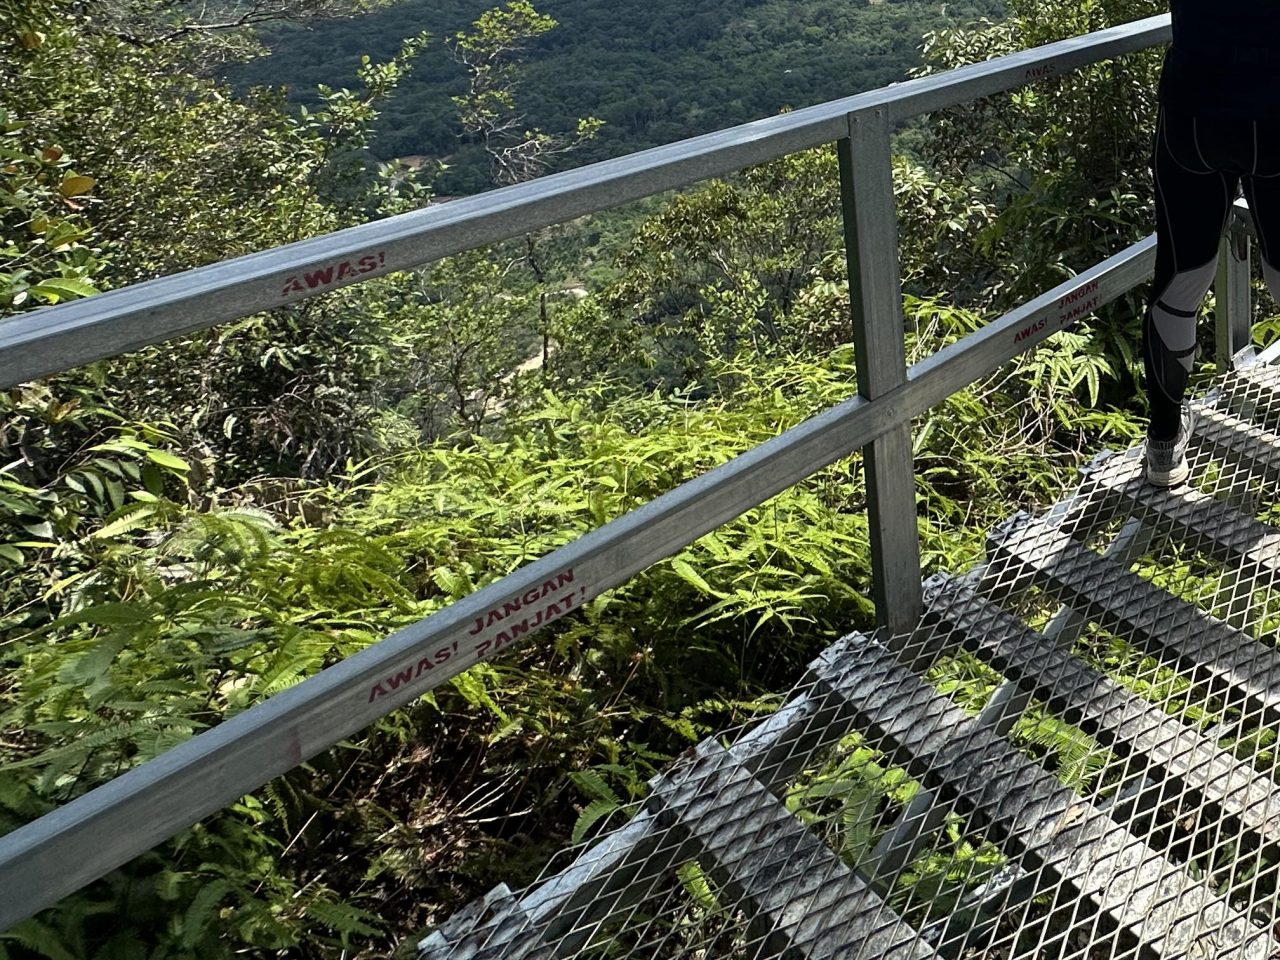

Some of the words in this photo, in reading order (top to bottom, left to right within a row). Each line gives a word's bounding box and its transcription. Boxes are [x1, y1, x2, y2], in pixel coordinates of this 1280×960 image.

[282, 252, 385, 296] AWAS!
[1058, 281, 1098, 309] JANGAN
[1014, 317, 1048, 344] AWAS!
[469, 569, 574, 635] JANGAN
[475, 586, 586, 658] PANJAT!
[368, 641, 458, 703] AWAS!
